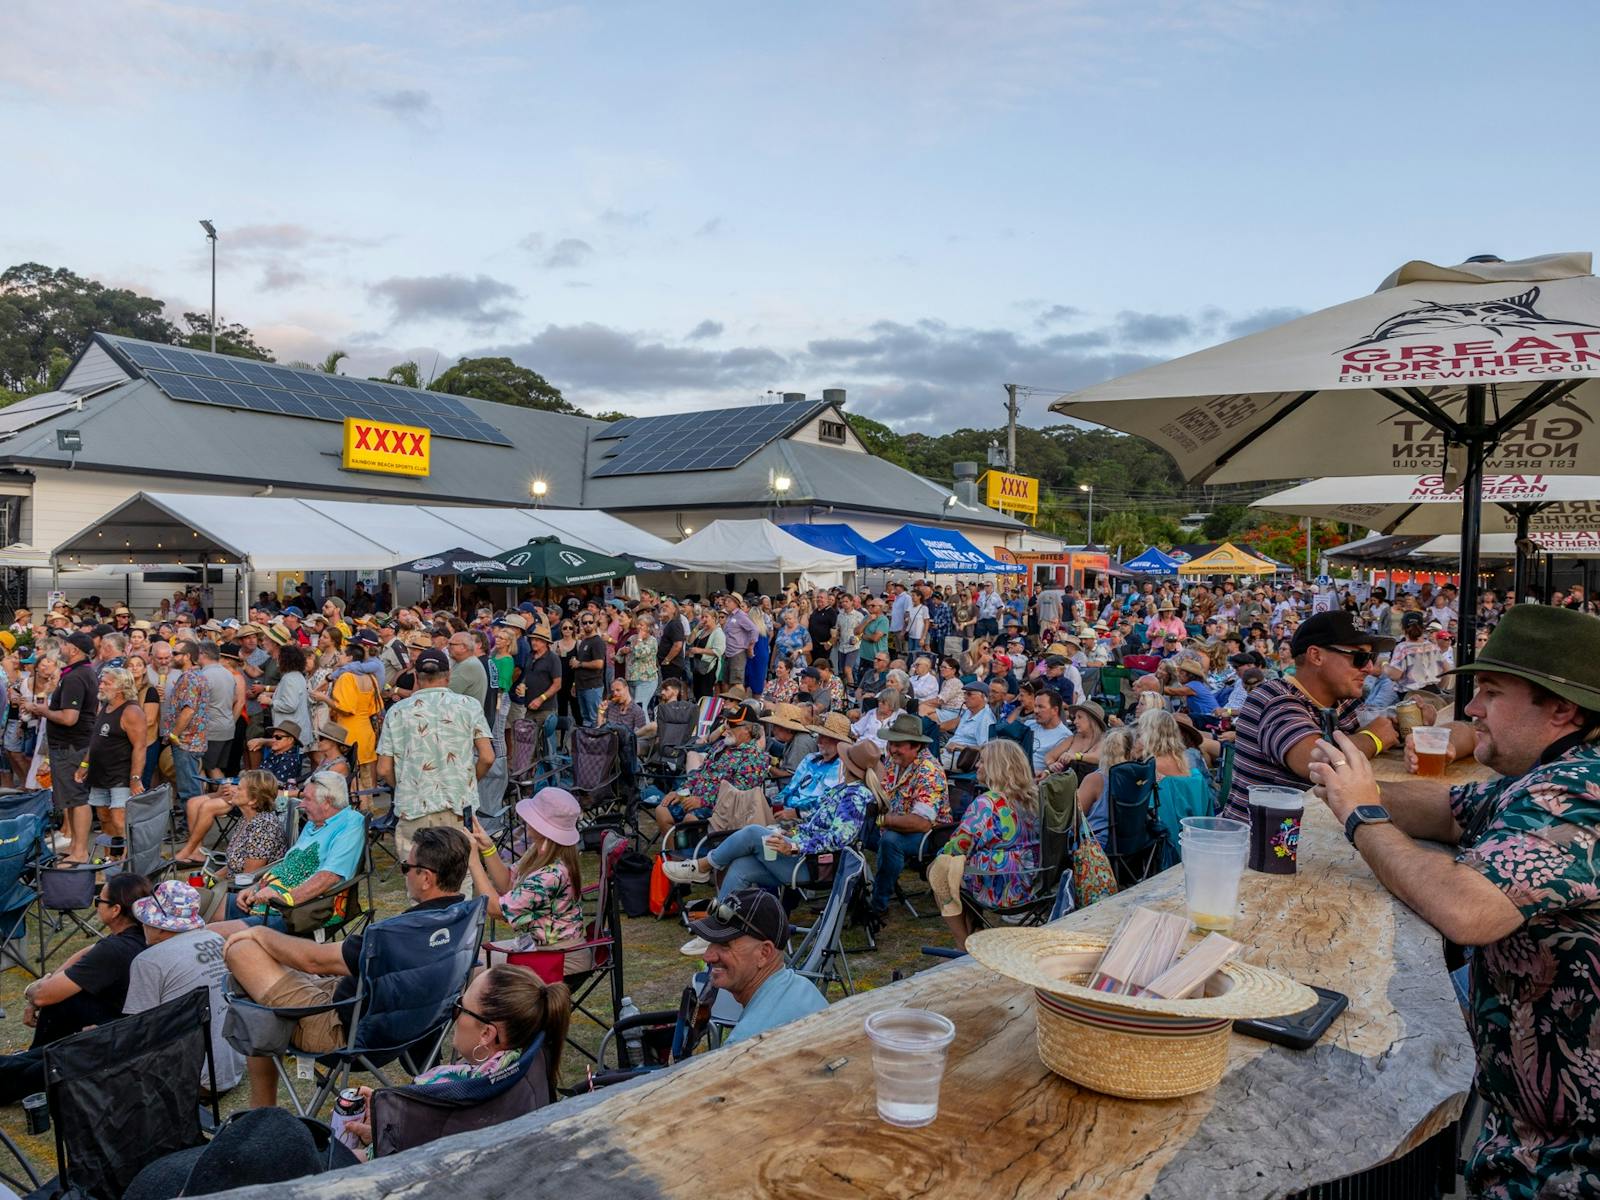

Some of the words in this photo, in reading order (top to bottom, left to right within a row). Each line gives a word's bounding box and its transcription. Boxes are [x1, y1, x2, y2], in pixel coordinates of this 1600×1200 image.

[1343, 331, 1600, 362] GREAT
[1339, 375, 1375, 383] EST
[1384, 368, 1518, 381] BREWING
[1528, 366, 1564, 374] CO
[1571, 364, 1600, 372] QL
[354, 425, 425, 457] XXXX
[1000, 476, 1028, 498] XXXX
[1411, 484, 1548, 496] NORHERN
[194, 937, 224, 951] COL
